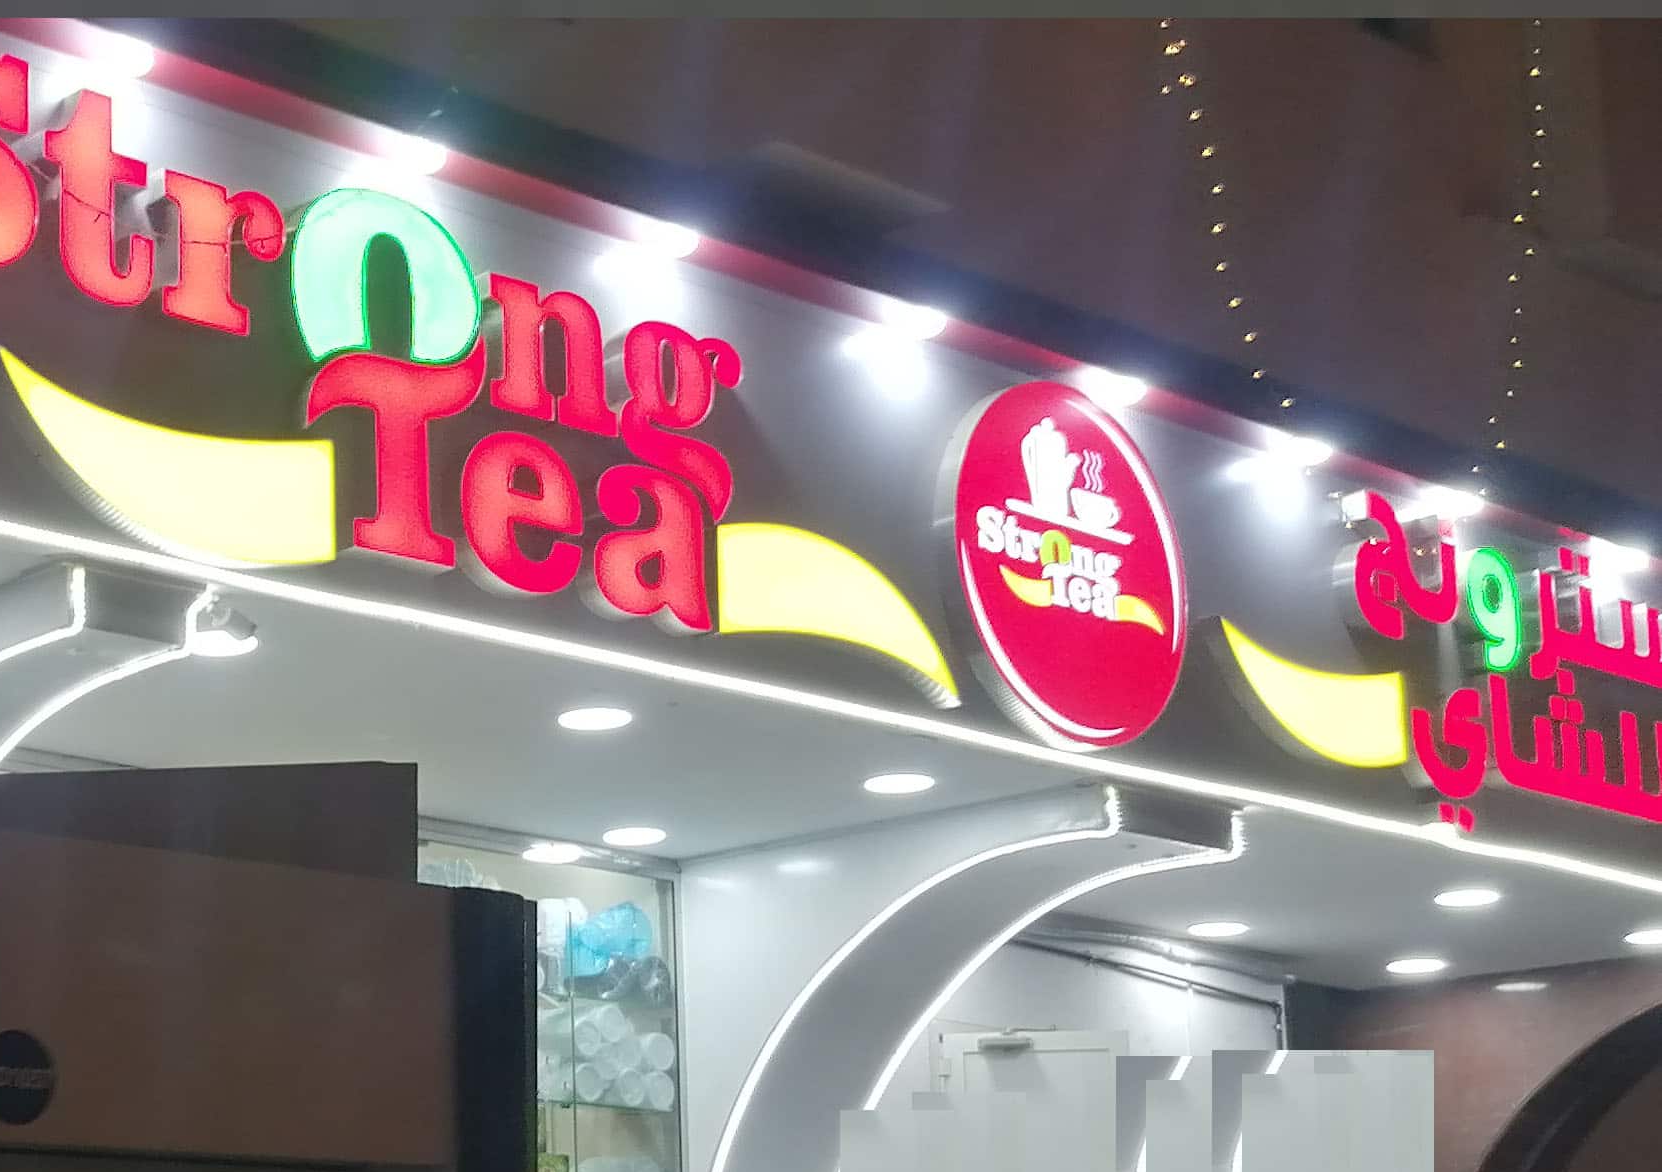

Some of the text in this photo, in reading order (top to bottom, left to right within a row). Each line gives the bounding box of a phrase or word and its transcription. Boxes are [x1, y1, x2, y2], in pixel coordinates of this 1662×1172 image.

[306, 334, 713, 634] Tea
[976, 505, 1123, 583] Strong
[1042, 562, 1117, 621] Tea
